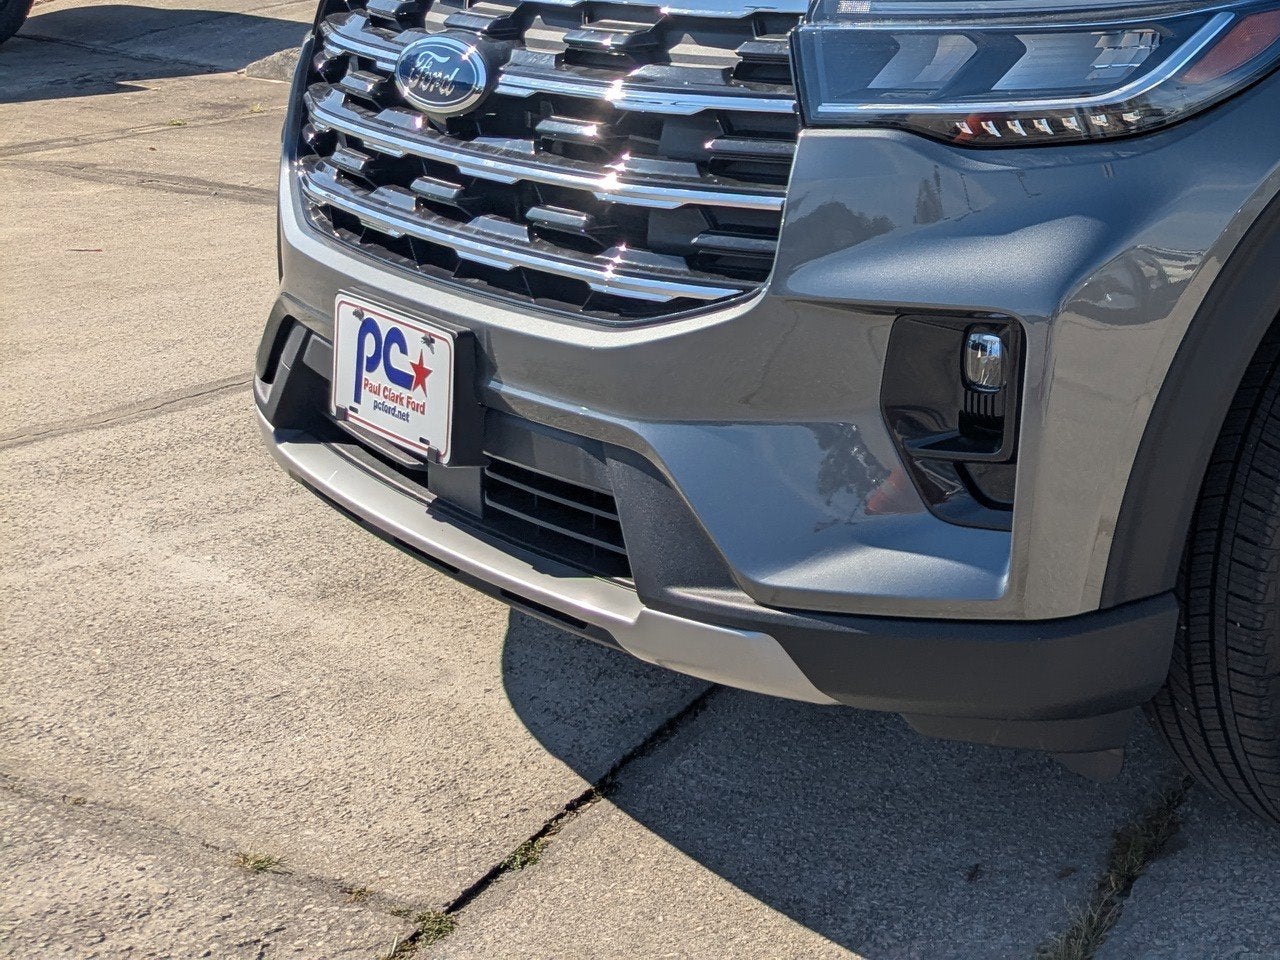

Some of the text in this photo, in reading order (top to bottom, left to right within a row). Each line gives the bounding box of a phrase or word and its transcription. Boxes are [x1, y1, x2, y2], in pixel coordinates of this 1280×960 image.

[408, 51, 460, 96] Ford
[363, 377, 426, 415] Paul Clark Ford
[373, 398, 410, 423] pcford.net
